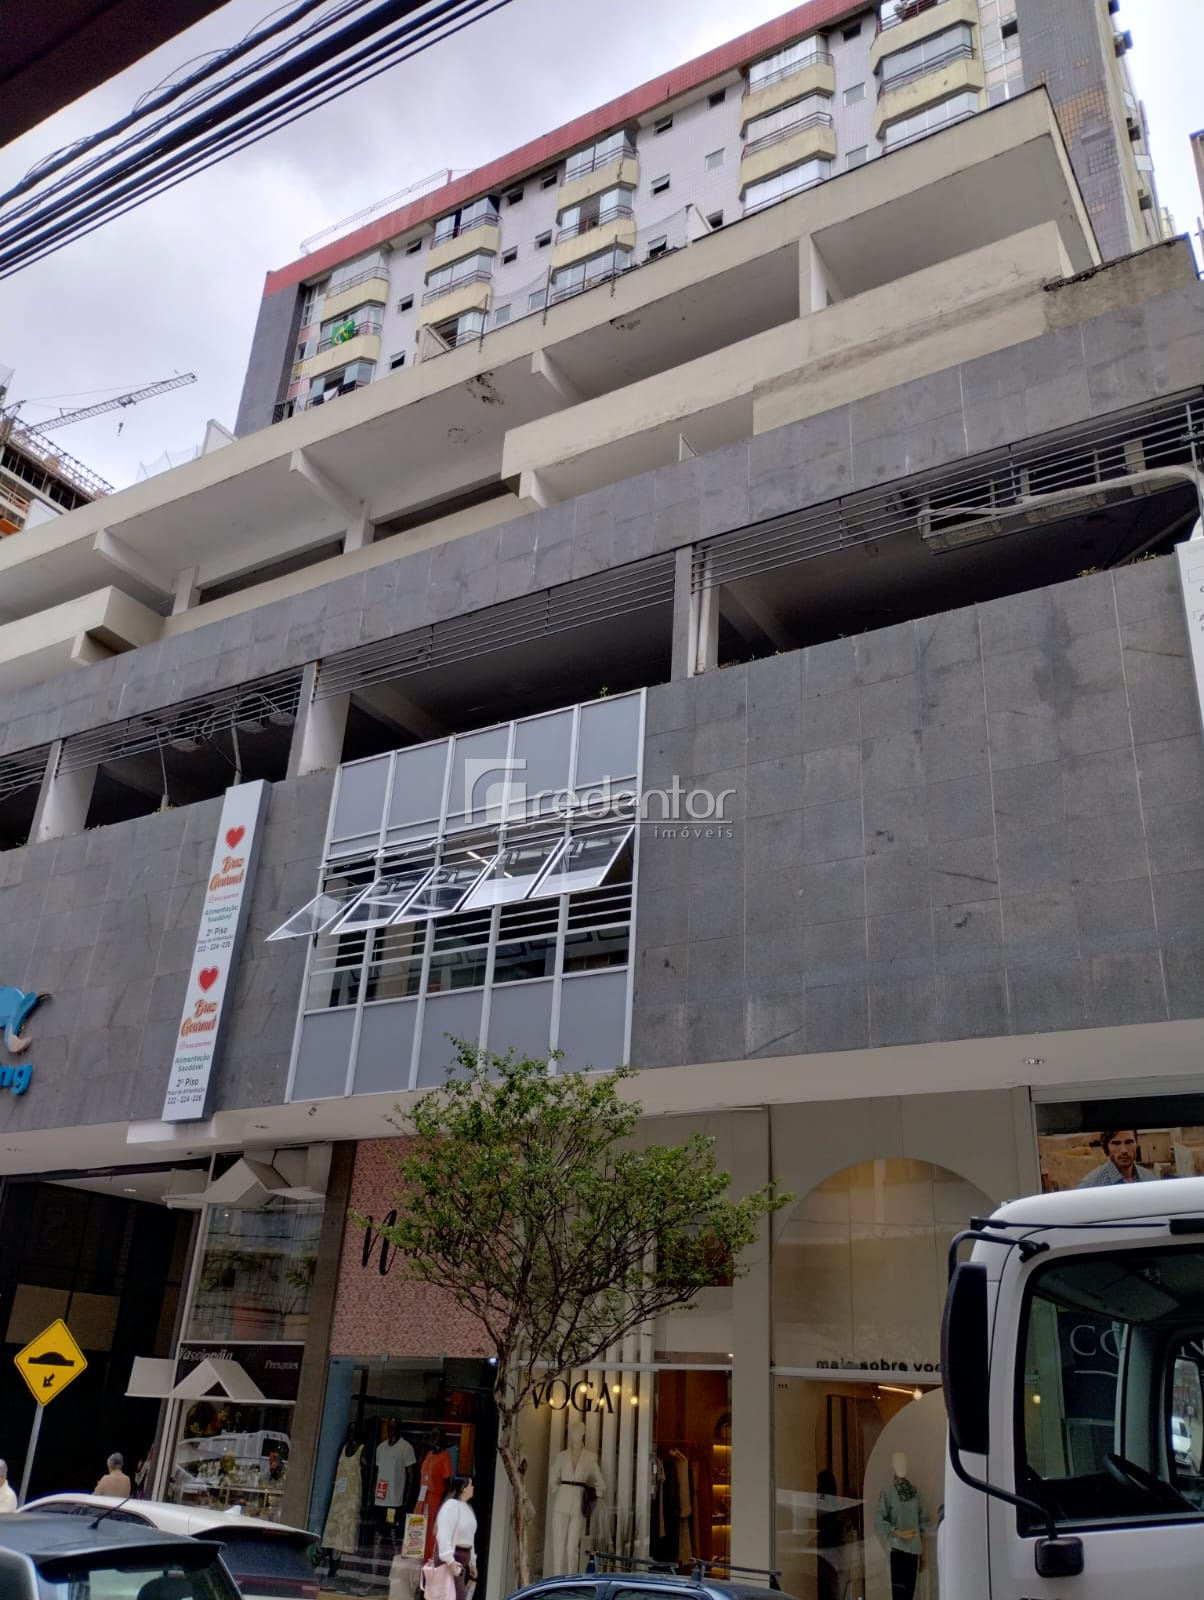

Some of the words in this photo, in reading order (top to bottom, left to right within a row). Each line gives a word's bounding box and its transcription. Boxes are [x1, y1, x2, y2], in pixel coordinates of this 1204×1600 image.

[222, 856, 245, 874] Braz
[209, 868, 245, 892] Gourmet
[204, 904, 239, 916] Alimentação
[214, 927, 228, 936] Piso
[194, 998, 217, 1019] Braz
[181, 1015, 217, 1038] Gourmet
[175, 1053, 210, 1064] Alimentação
[185, 1077, 199, 1087] Piso
[859, 1358, 908, 1371] sobre
[531, 1379, 614, 1414] VOGA
